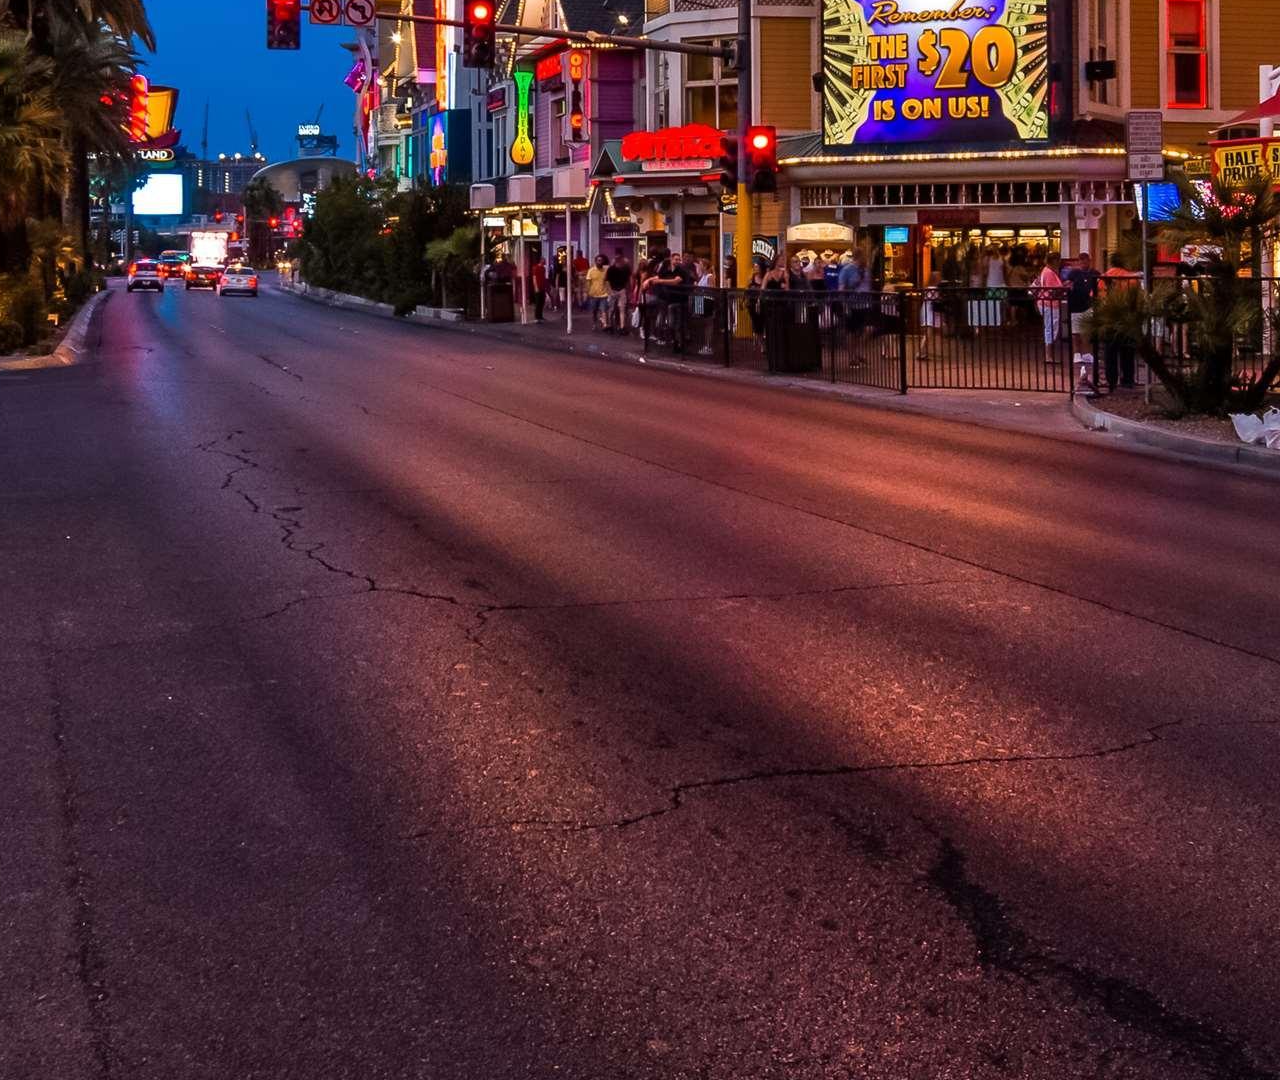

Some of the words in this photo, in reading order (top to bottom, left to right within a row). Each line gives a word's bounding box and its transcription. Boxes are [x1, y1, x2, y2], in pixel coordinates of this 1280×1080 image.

[867, 33, 908, 61] THE
[917, 25, 1017, 89] $20
[851, 63, 909, 89] FIRST
[873, 99, 896, 121] IS
[901, 97, 942, 120] ON
[947, 95, 990, 118] US!
[1224, 149, 1260, 167] HALF
